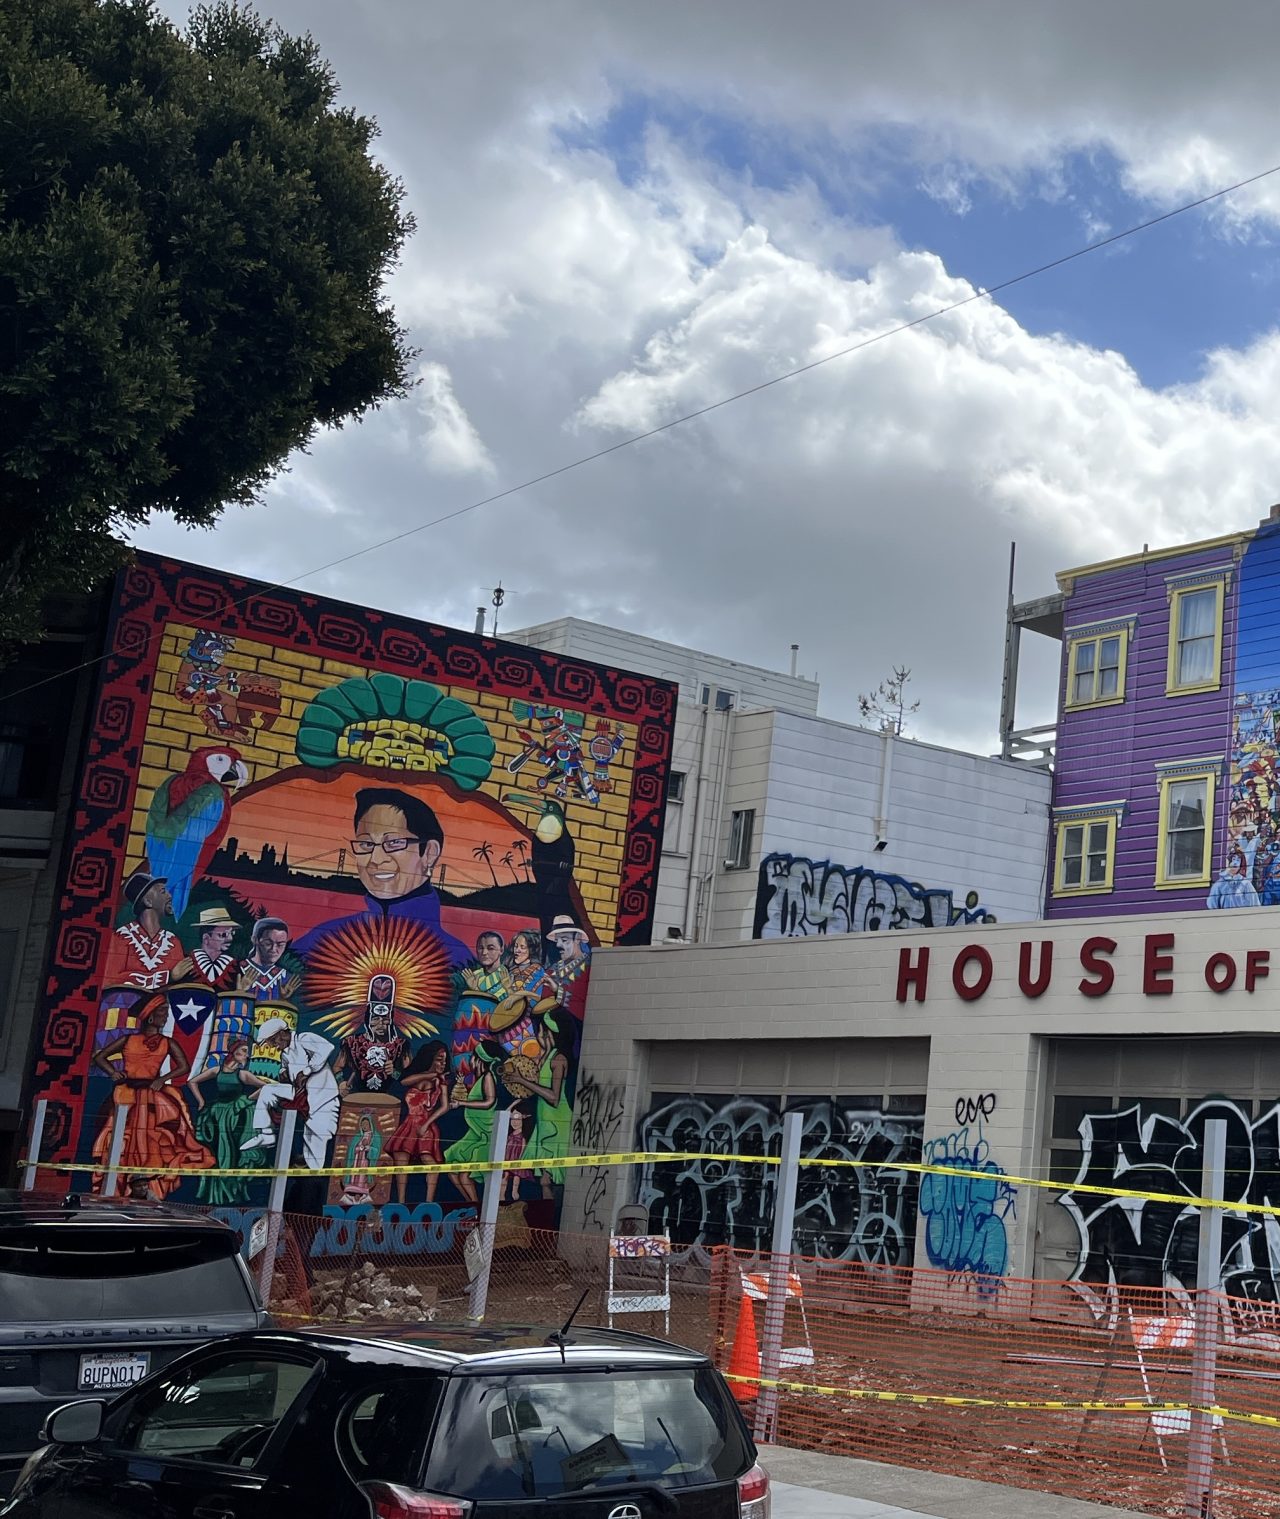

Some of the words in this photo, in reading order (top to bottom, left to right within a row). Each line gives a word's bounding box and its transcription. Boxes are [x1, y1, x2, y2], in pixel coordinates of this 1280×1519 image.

[895, 932, 1175, 1003] HOUSE
[1204, 950, 1270, 993] OF
[24, 1328, 113, 1340] RANGE
[128, 1324, 209, 1336] ROVER
[84, 1365, 145, 1384] 8UPN017
